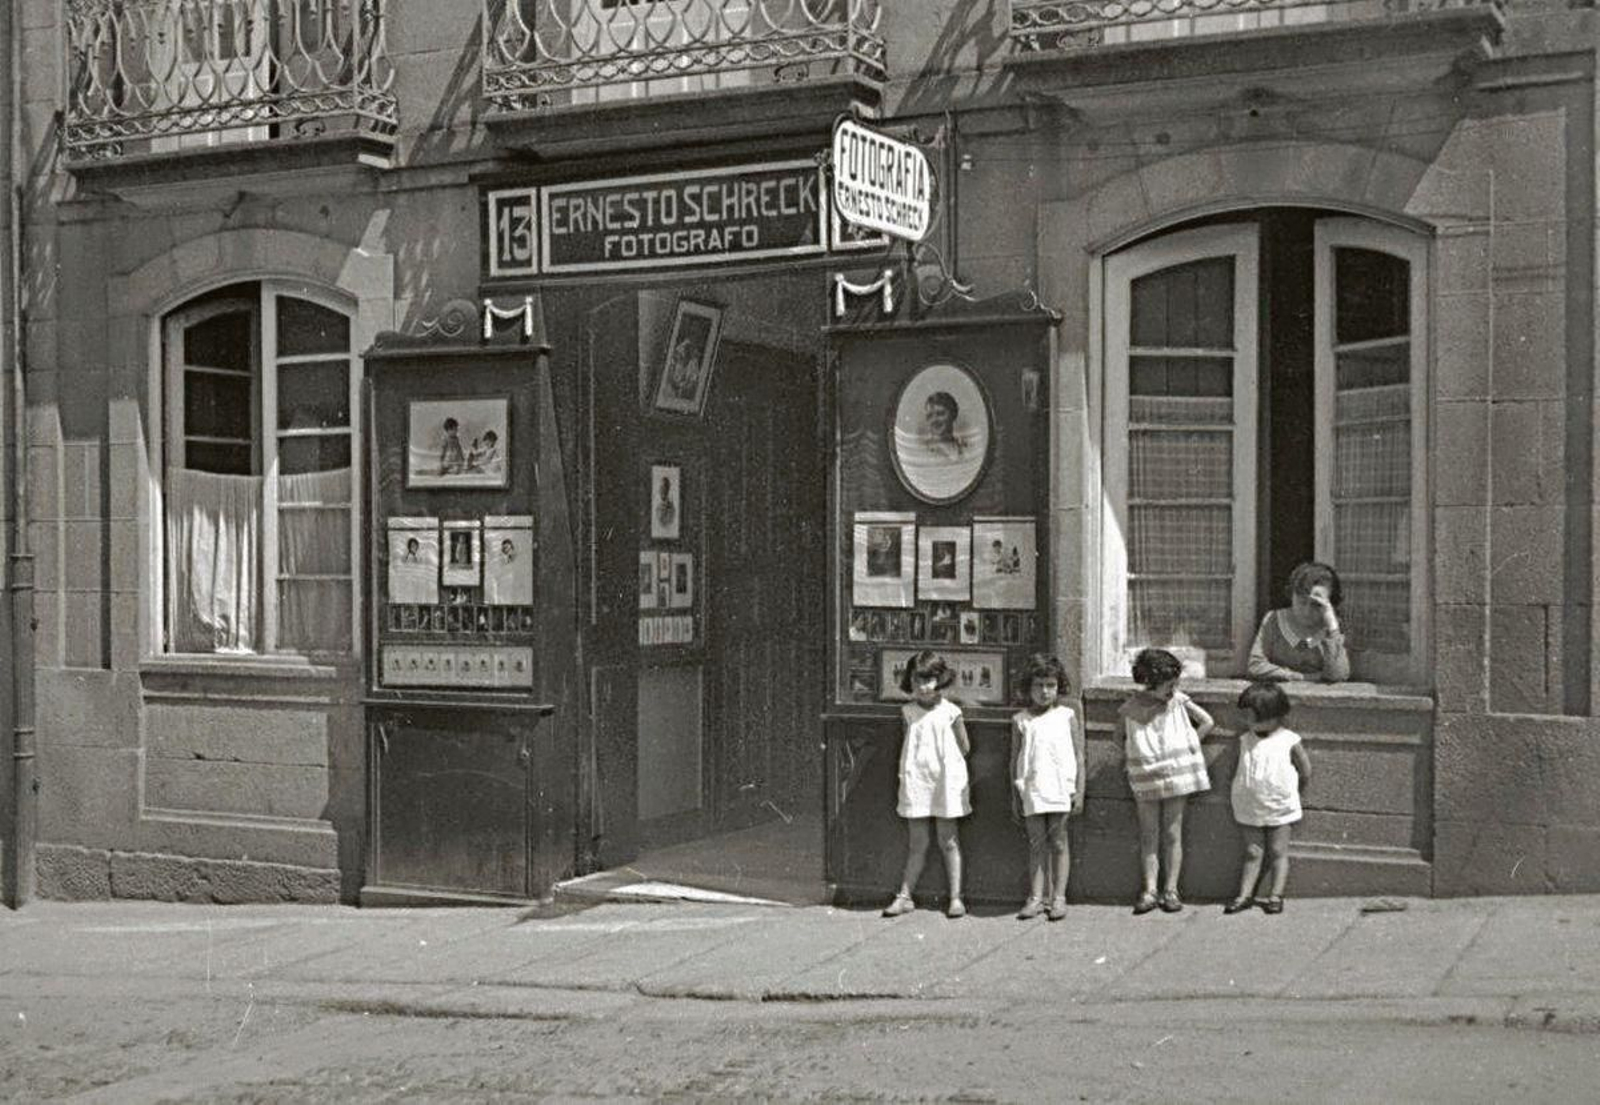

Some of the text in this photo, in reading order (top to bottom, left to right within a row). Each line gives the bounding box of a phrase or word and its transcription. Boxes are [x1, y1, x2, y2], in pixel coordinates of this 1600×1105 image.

[841, 128, 925, 203] FOTOGRAFIA
[499, 205, 532, 262] 13
[551, 174, 817, 236] ERNESTO SCHRECK
[838, 180, 924, 231] ERNESTO SCHRECK
[604, 225, 758, 258] FOTOGRAFO
